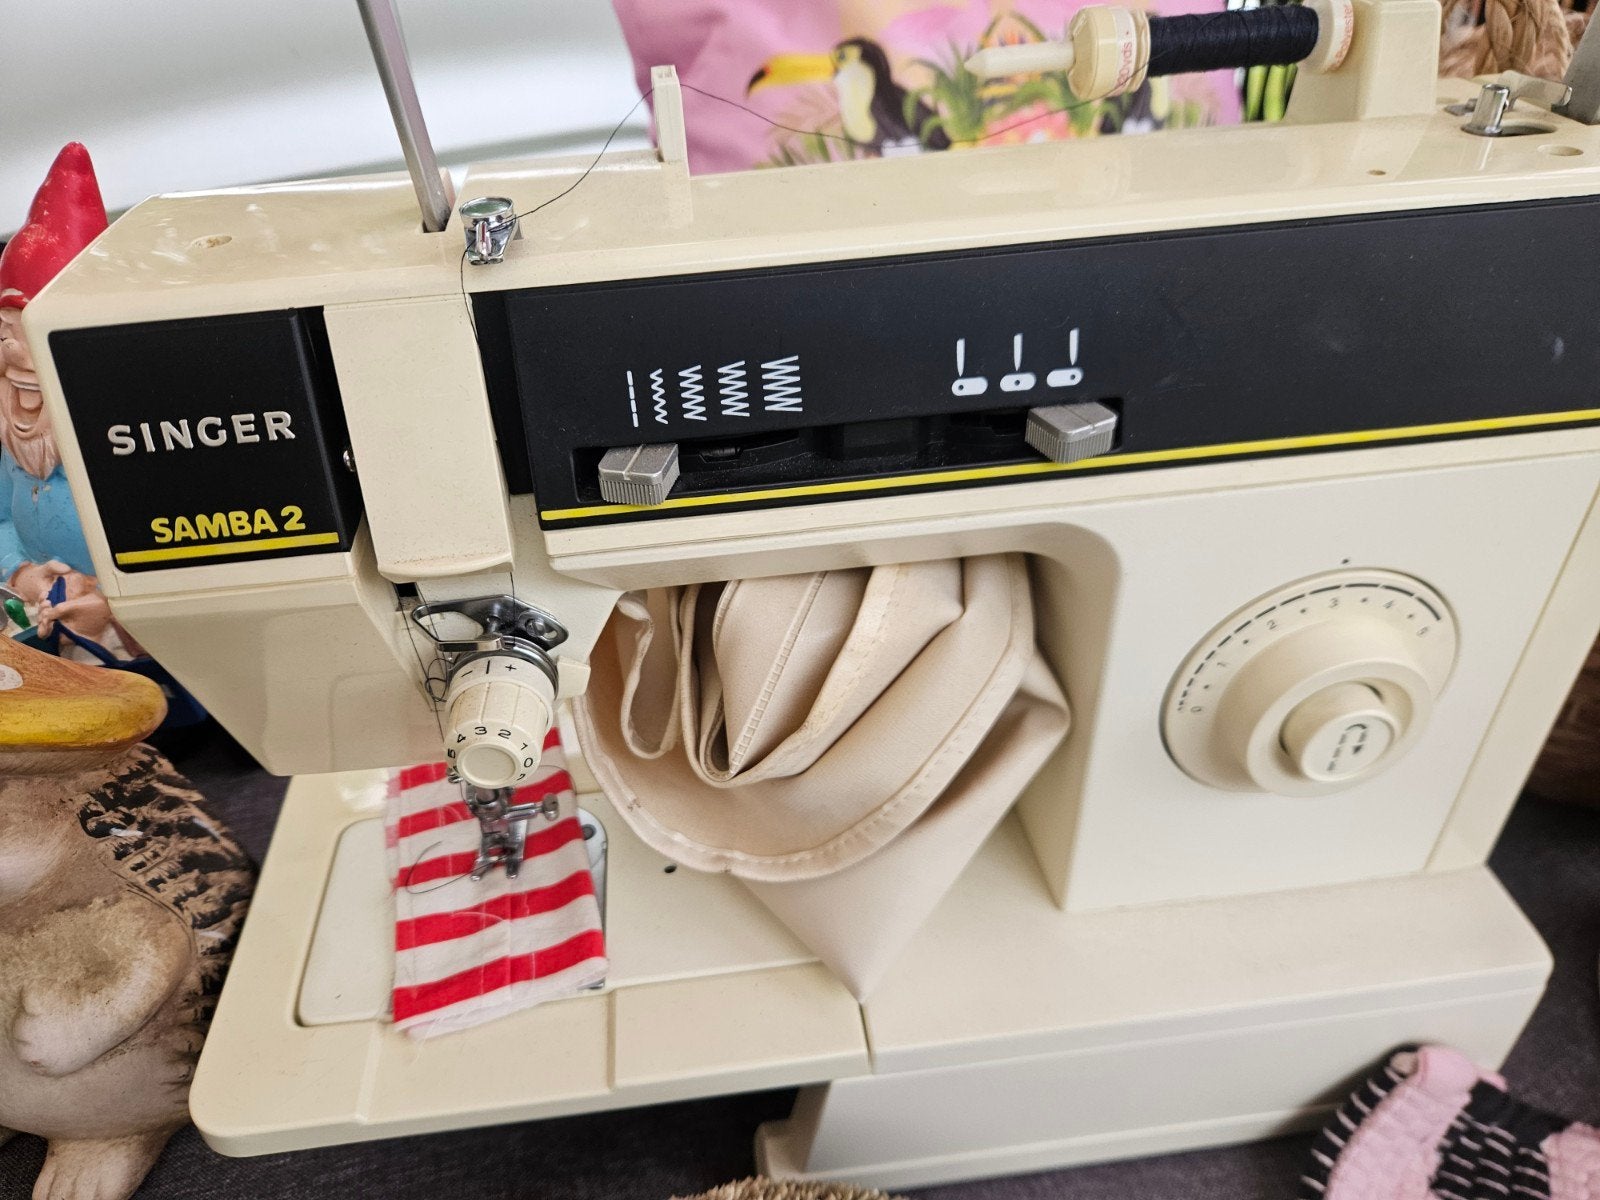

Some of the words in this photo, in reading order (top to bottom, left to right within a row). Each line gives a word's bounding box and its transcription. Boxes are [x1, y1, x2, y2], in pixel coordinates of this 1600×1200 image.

[107, 410, 296, 455] SINGER
[150, 508, 278, 543] SAMBA
[280, 505, 306, 531] 2
[474, 726, 488, 735] 3
[497, 729, 512, 740] 2
[456, 733, 467, 743] 4
[447, 748, 456, 759] 5
[523, 757, 534, 768] 0
